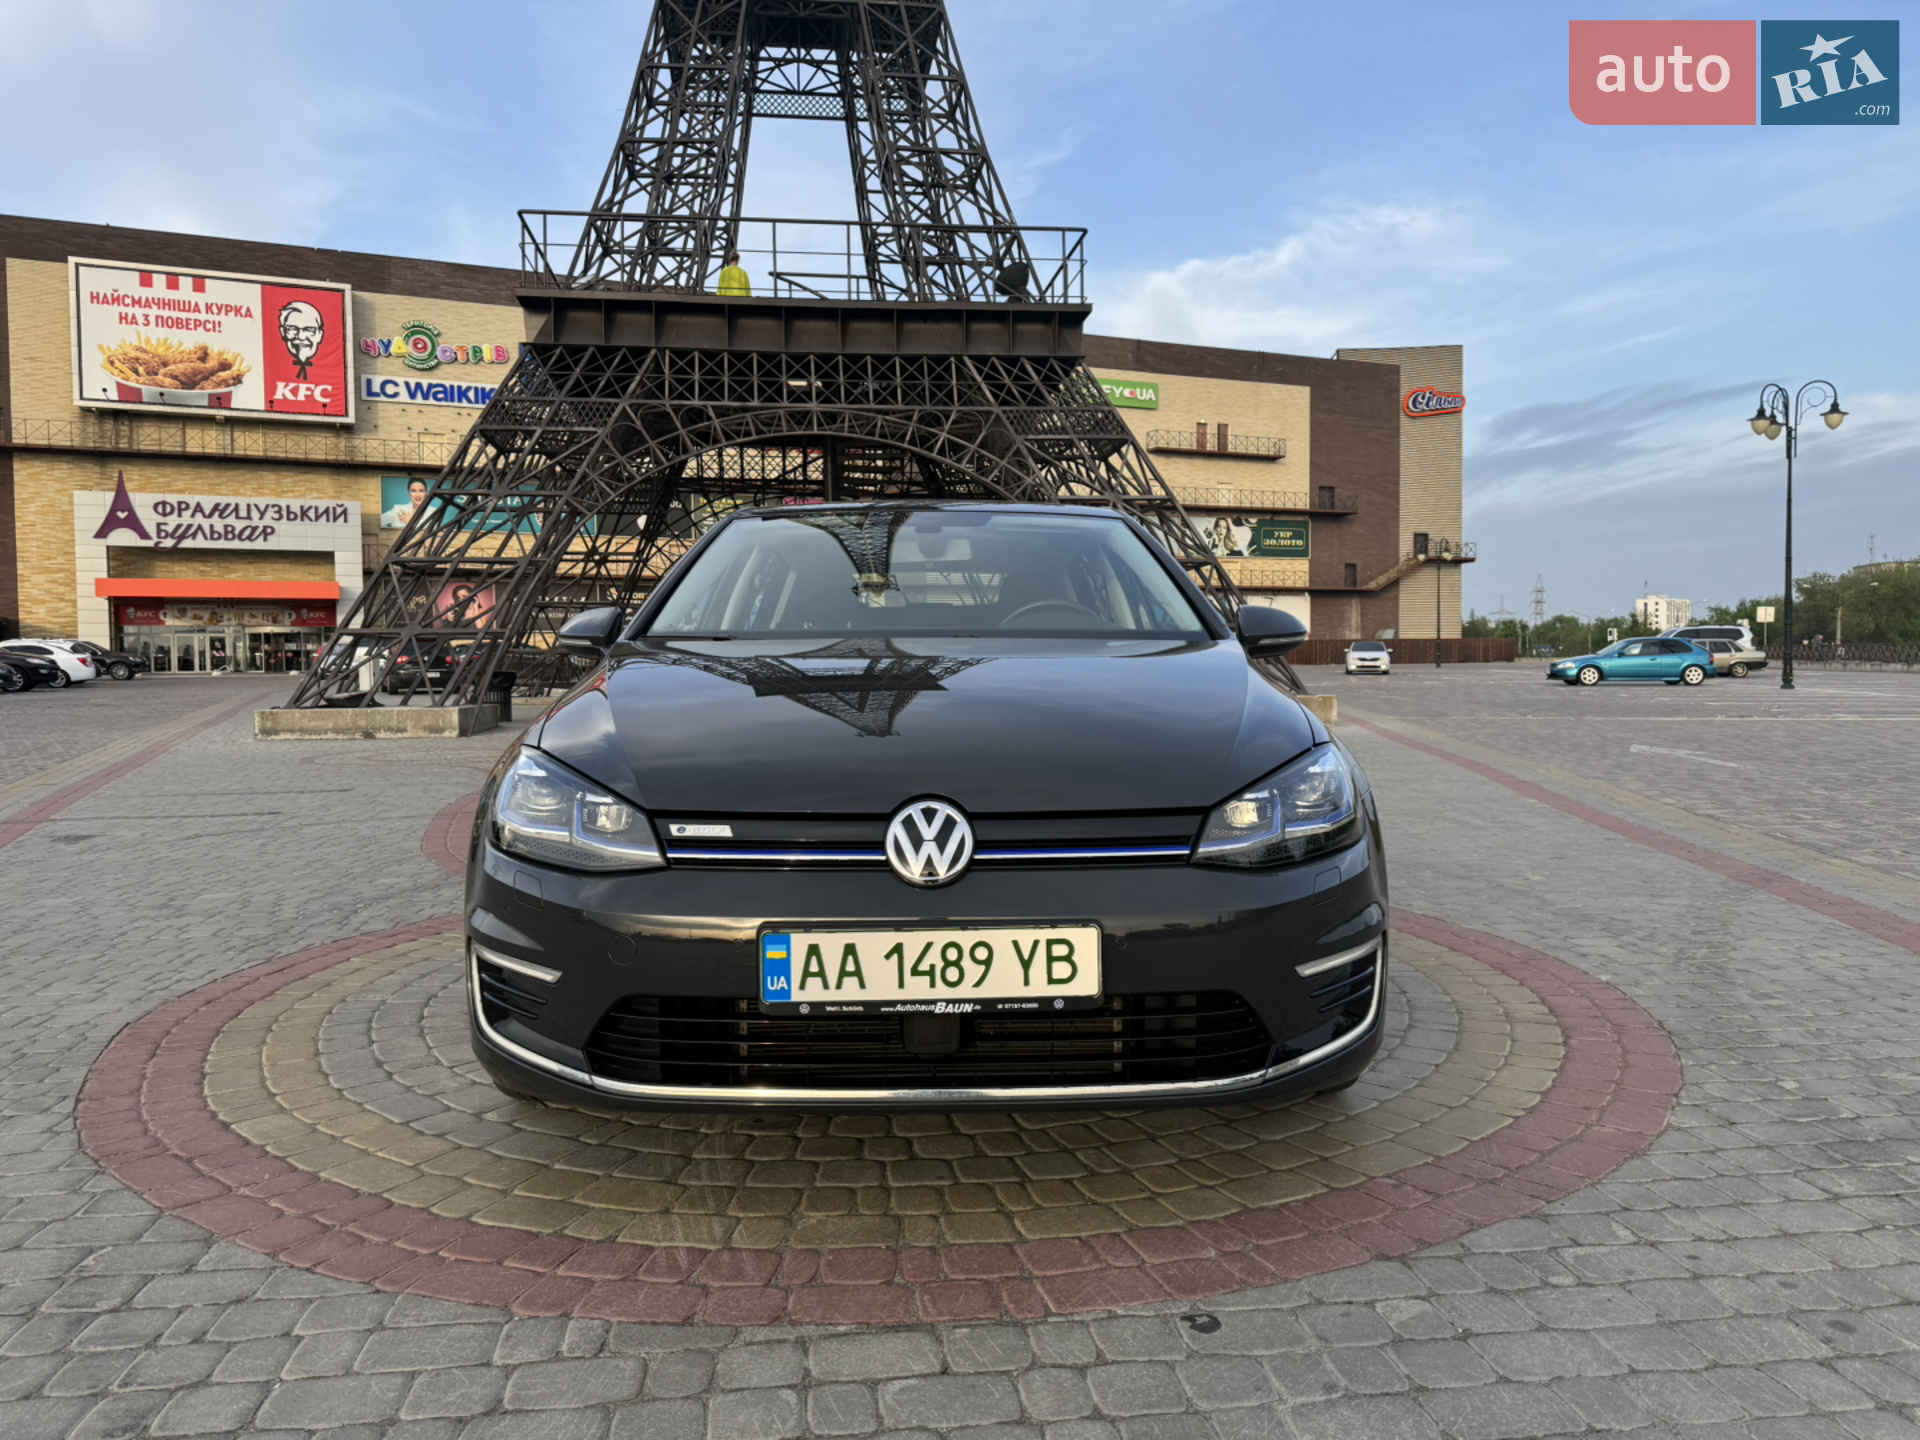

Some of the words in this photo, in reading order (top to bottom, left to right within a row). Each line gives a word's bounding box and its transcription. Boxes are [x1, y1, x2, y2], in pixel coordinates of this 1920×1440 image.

[90, 289, 202, 315] НАЙСМАЧНІША
[205, 303, 254, 319] КУРКА
[118, 311, 139, 327] НА
[142, 313, 151, 327] 3
[155, 314, 223, 333] ПОВЕРСІ!
[273, 381, 333, 403] KFC
[365, 378, 401, 399] LC
[152, 500, 349, 524] ФРАНЦУЗЬКИЙ
[154, 522, 276, 550] БУЛЬВАР
[1263, 538, 1304, 547] ЗОЛОТО
[1273, 530, 1294, 539] УКР
[136, 610, 156, 618] KFC
[308, 611, 327, 619] KFC
[798, 943, 867, 991] AA
[884, 940, 994, 989] 1489
[1011, 938, 1079, 987] YB
[766, 976, 789, 990] UA
